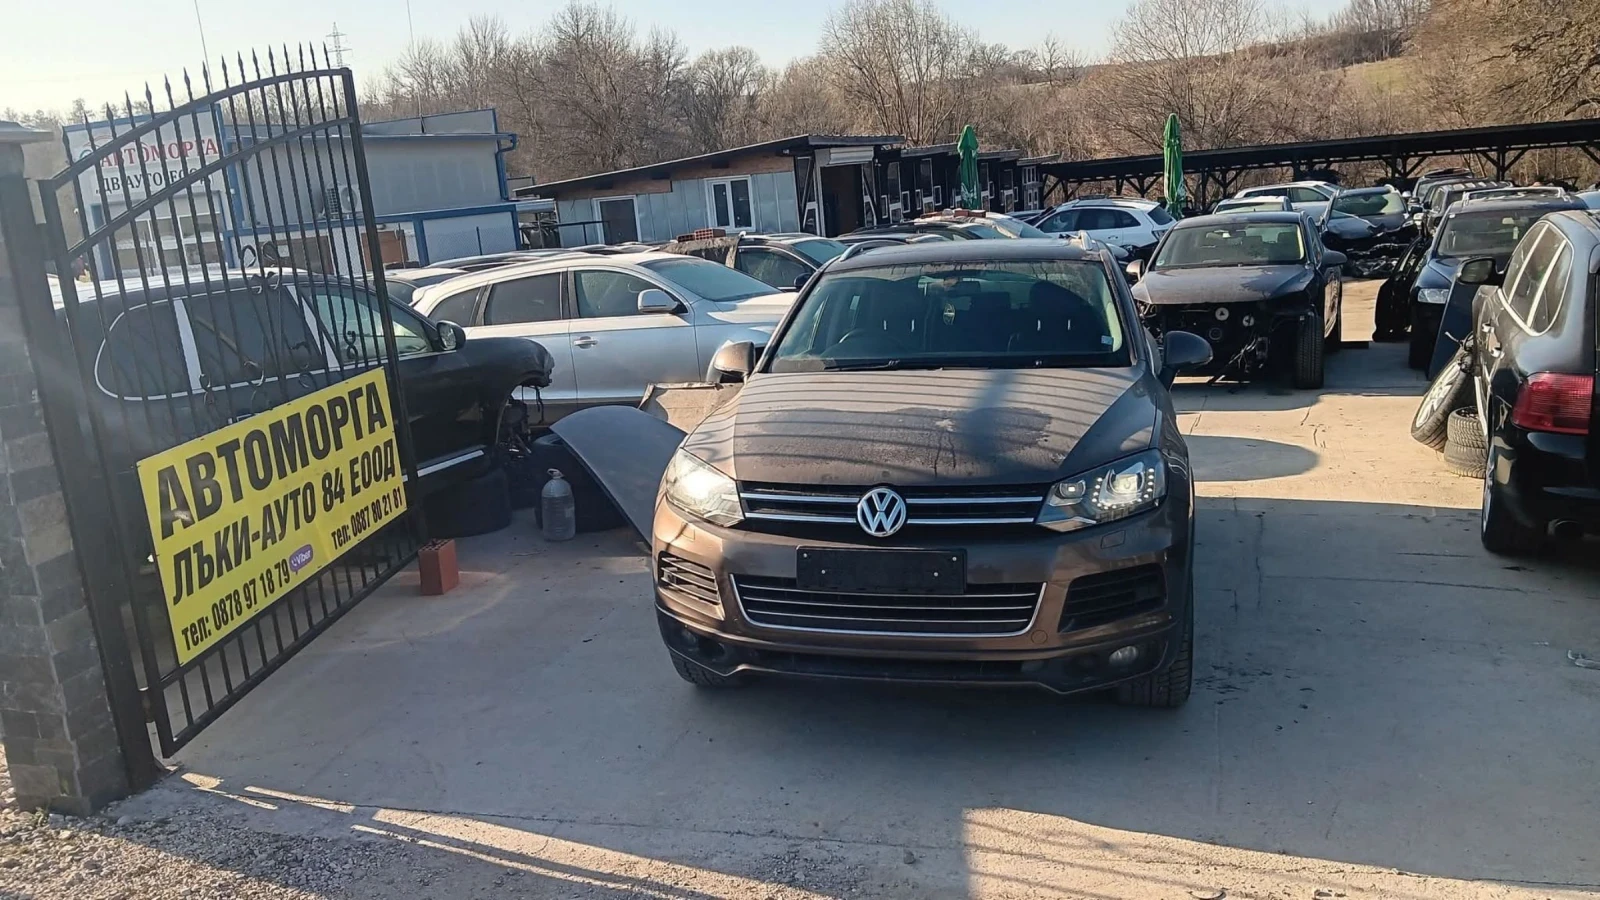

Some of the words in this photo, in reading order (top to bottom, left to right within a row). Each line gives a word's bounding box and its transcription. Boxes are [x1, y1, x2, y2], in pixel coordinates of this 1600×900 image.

[157, 381, 388, 539] АВТОМОРГА
[173, 481, 316, 606] ЛЪКИ-АУТО
[321, 467, 345, 513] 84
[350, 438, 396, 497] ЕООД
[296, 549, 311, 565] Viber
[331, 524, 351, 550] тел:
[350, 505, 371, 537] 0887
[371, 498, 383, 524] 80
[382, 492, 393, 516] 21
[393, 486, 403, 509] 81
[181, 616, 212, 651] тел:
[211, 589, 243, 631] 0878
[243, 578, 258, 609] 97
[259, 568, 275, 598] 18
[274, 558, 290, 588] 79
